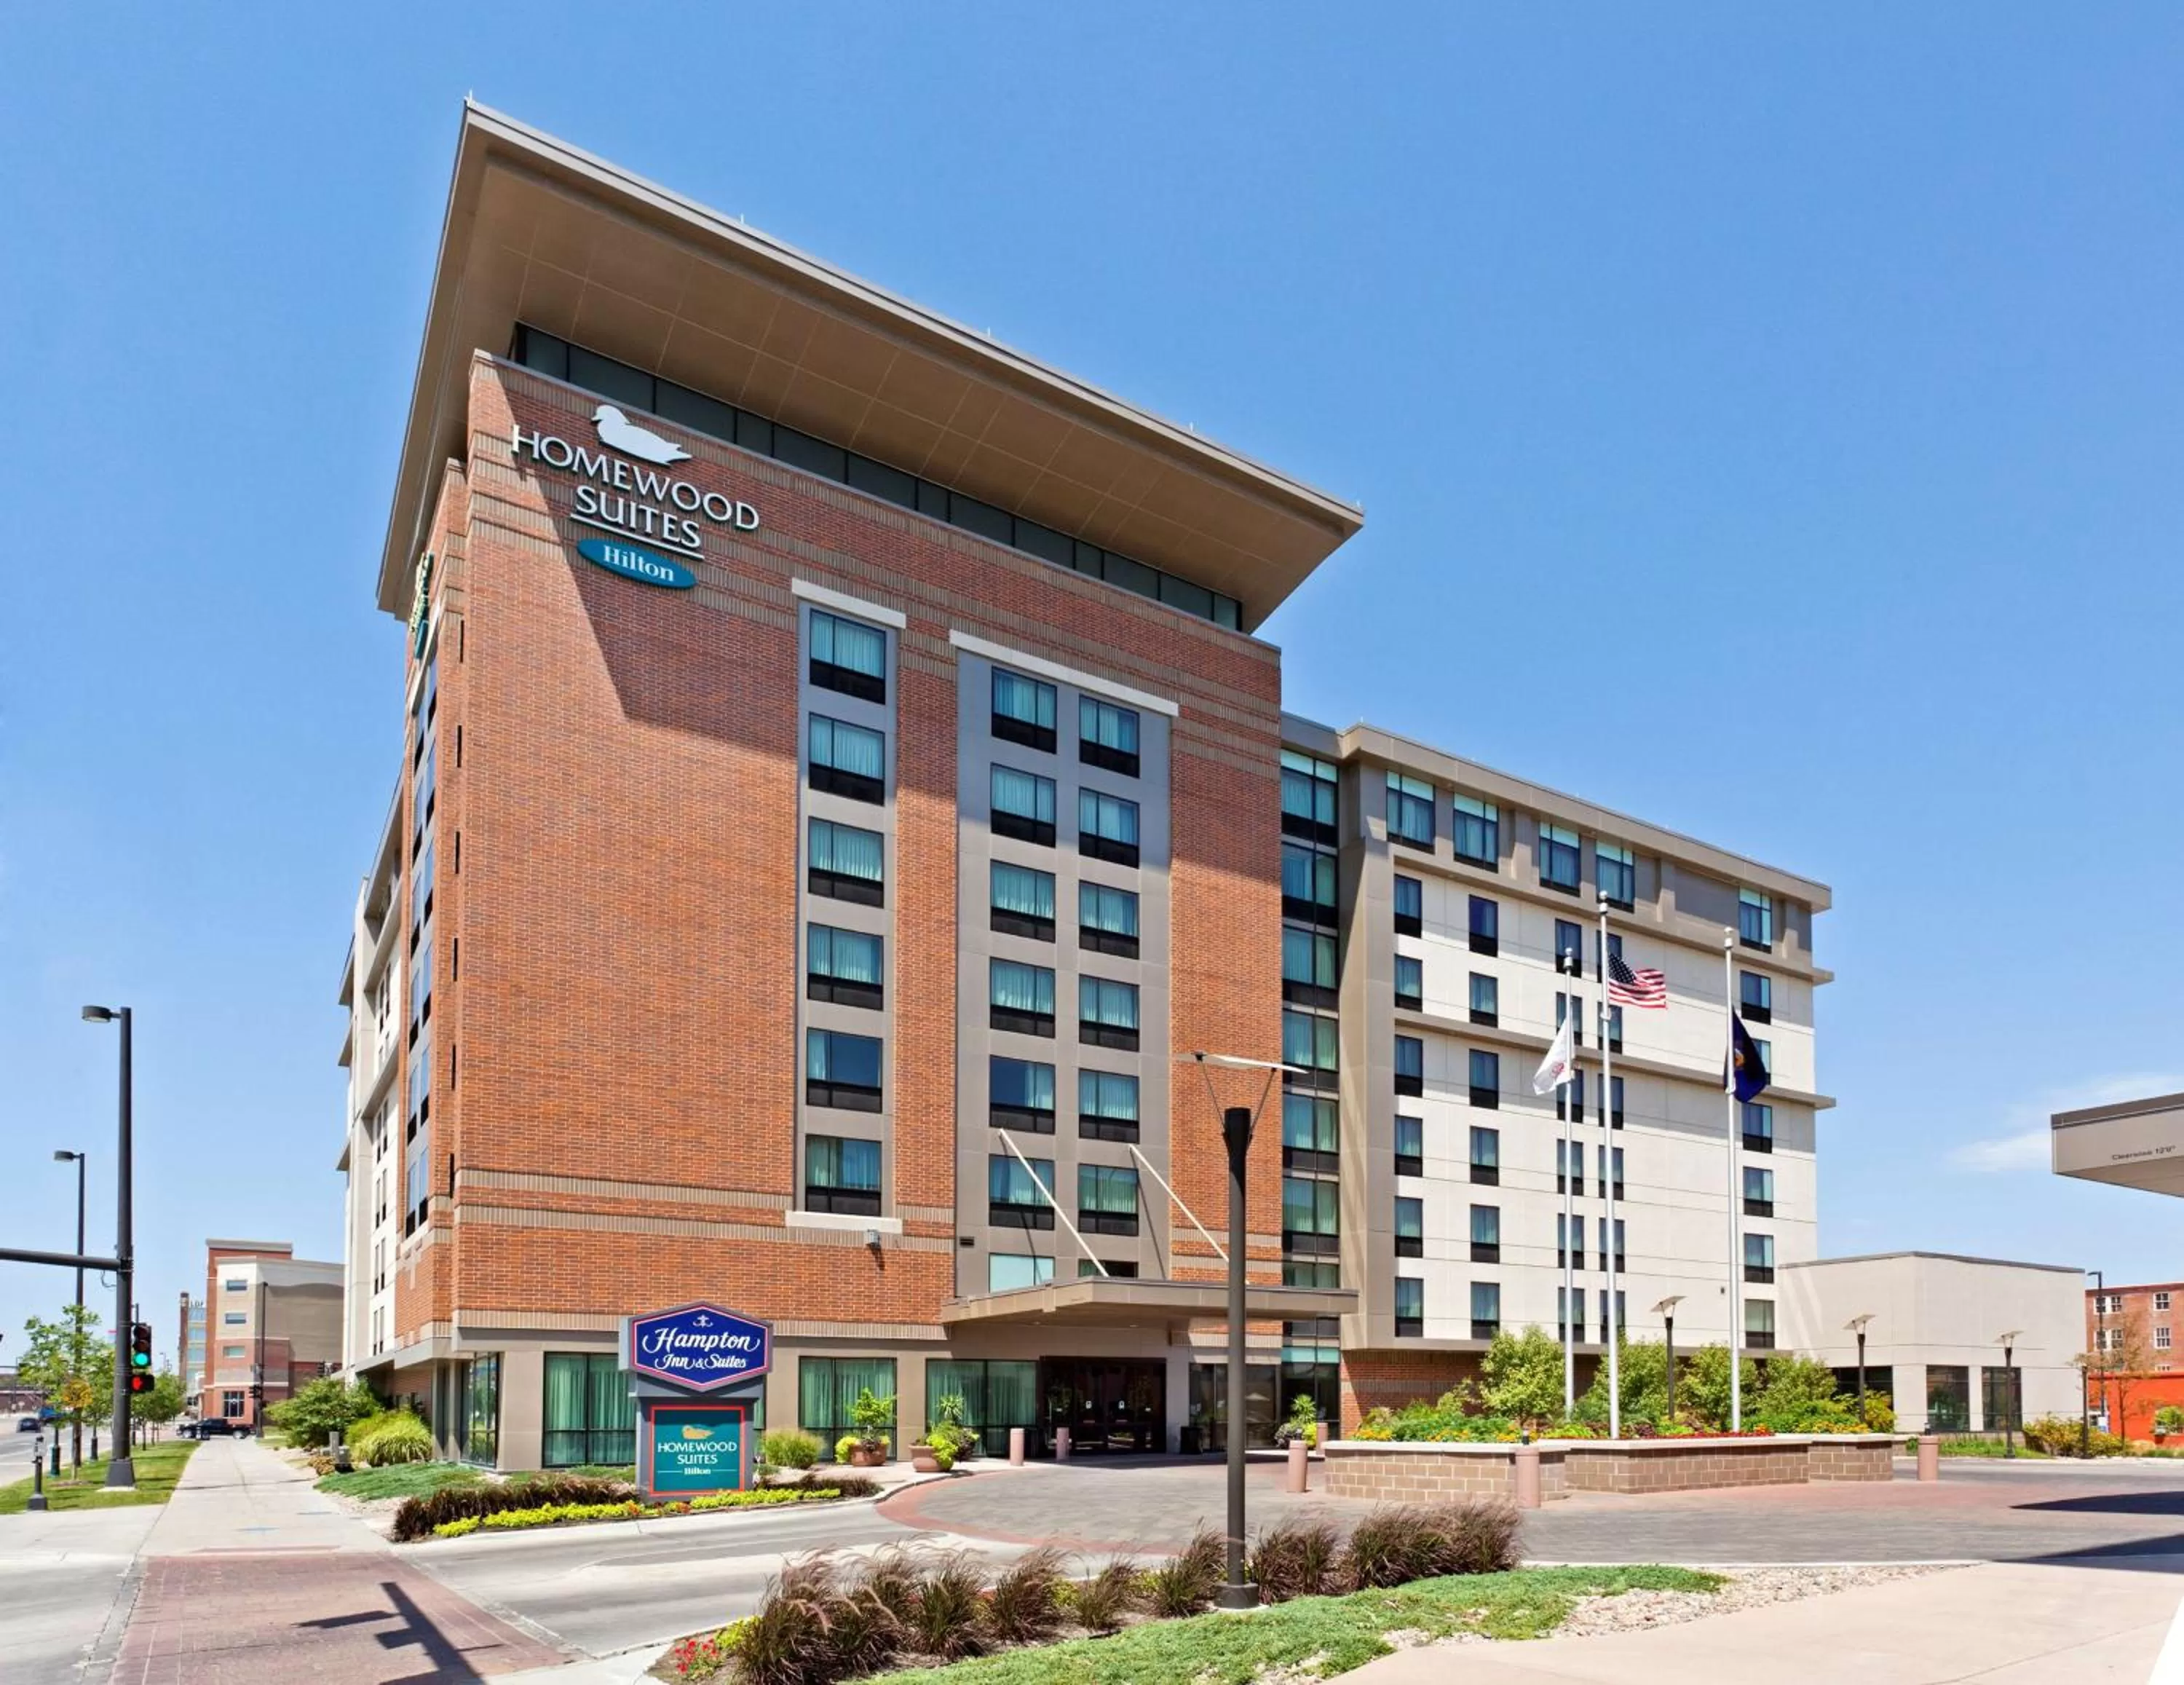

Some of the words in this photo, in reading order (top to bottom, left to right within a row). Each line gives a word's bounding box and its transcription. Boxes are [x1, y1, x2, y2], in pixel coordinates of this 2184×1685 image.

[511, 424, 760, 530] HOMEWOOD
[576, 485, 701, 549] SUITES
[603, 544, 676, 583] Hilton
[642, 1327, 761, 1353] Hampton
[655, 1354, 695, 1370] Inn
[695, 1357, 704, 1369] &
[704, 1354, 747, 1369] Suites
[657, 1442, 737, 1453] HOMEWOOD
[677, 1454, 719, 1464] SUITES
[684, 1467, 711, 1475] Hilton
